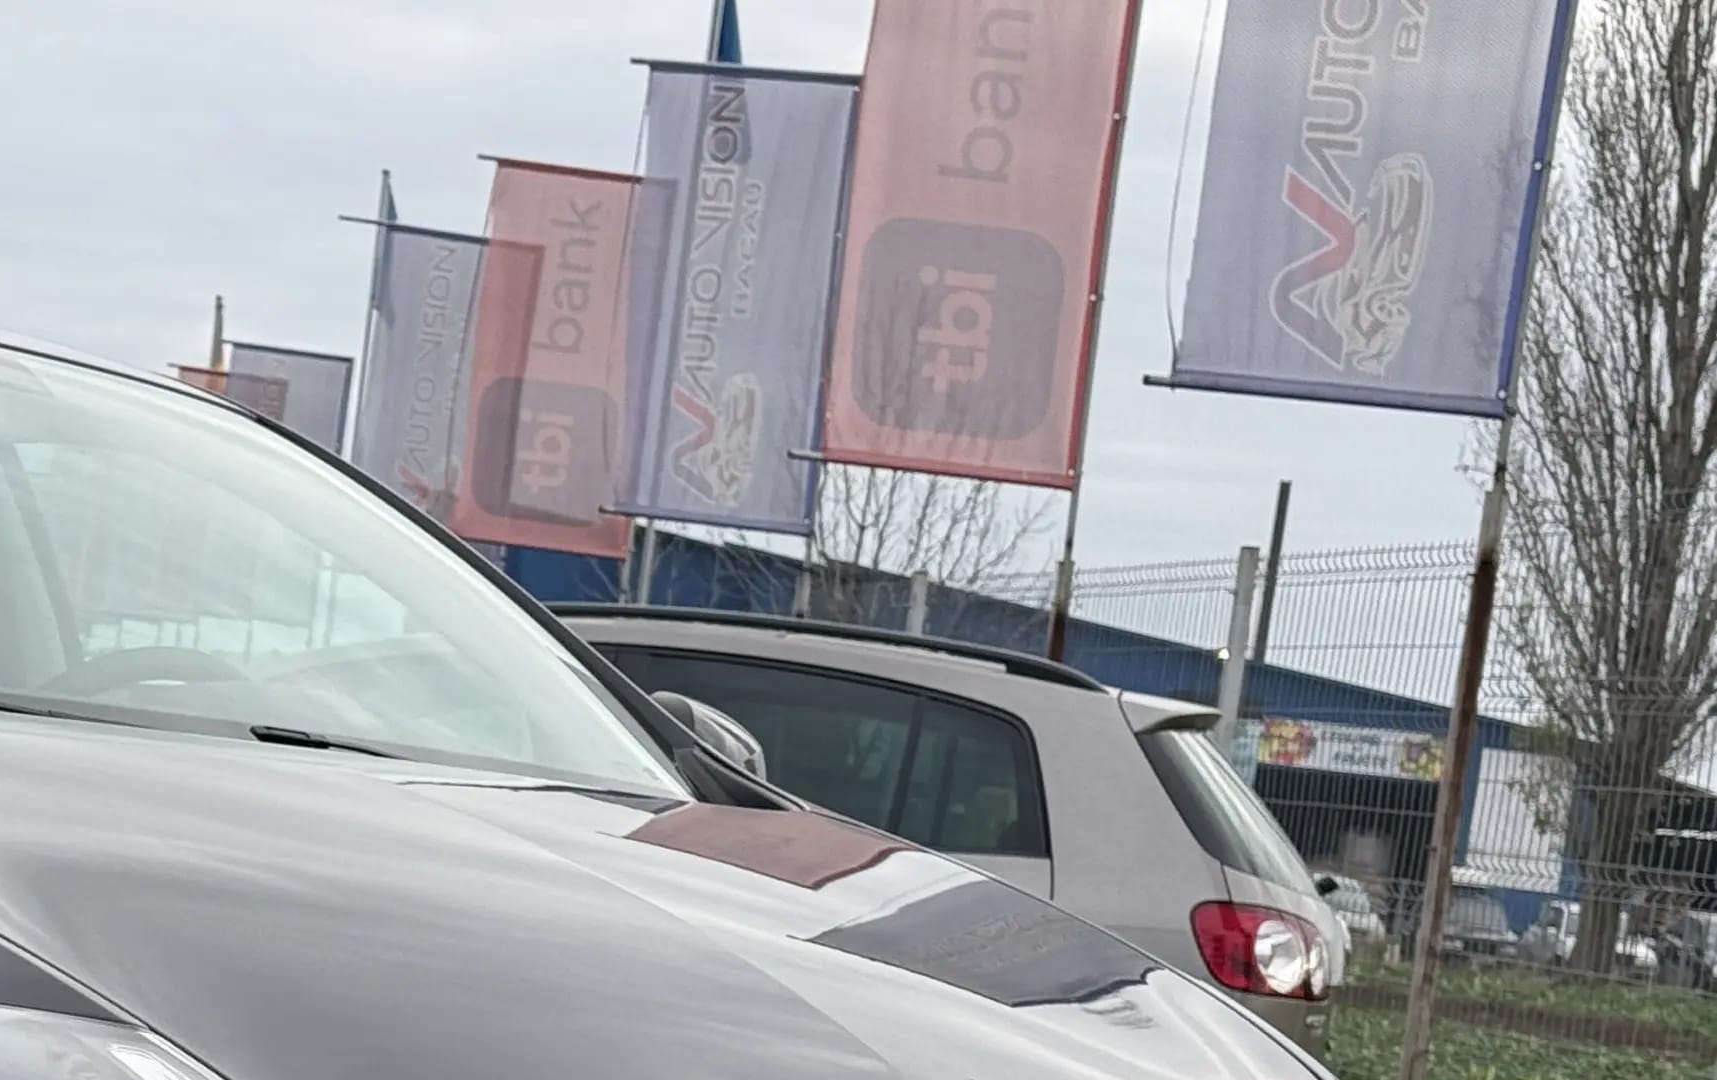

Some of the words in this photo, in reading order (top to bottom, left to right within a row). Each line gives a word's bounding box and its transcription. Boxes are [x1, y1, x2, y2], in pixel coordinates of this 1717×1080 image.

[692, 84, 746, 253] VISION
[413, 243, 457, 368] VISION
[532, 199, 602, 355] bank
[682, 267, 723, 401] AUTO
[916, 264, 998, 392] tbi
[403, 376, 435, 474] AUTO
[520, 408, 574, 495] tbi
